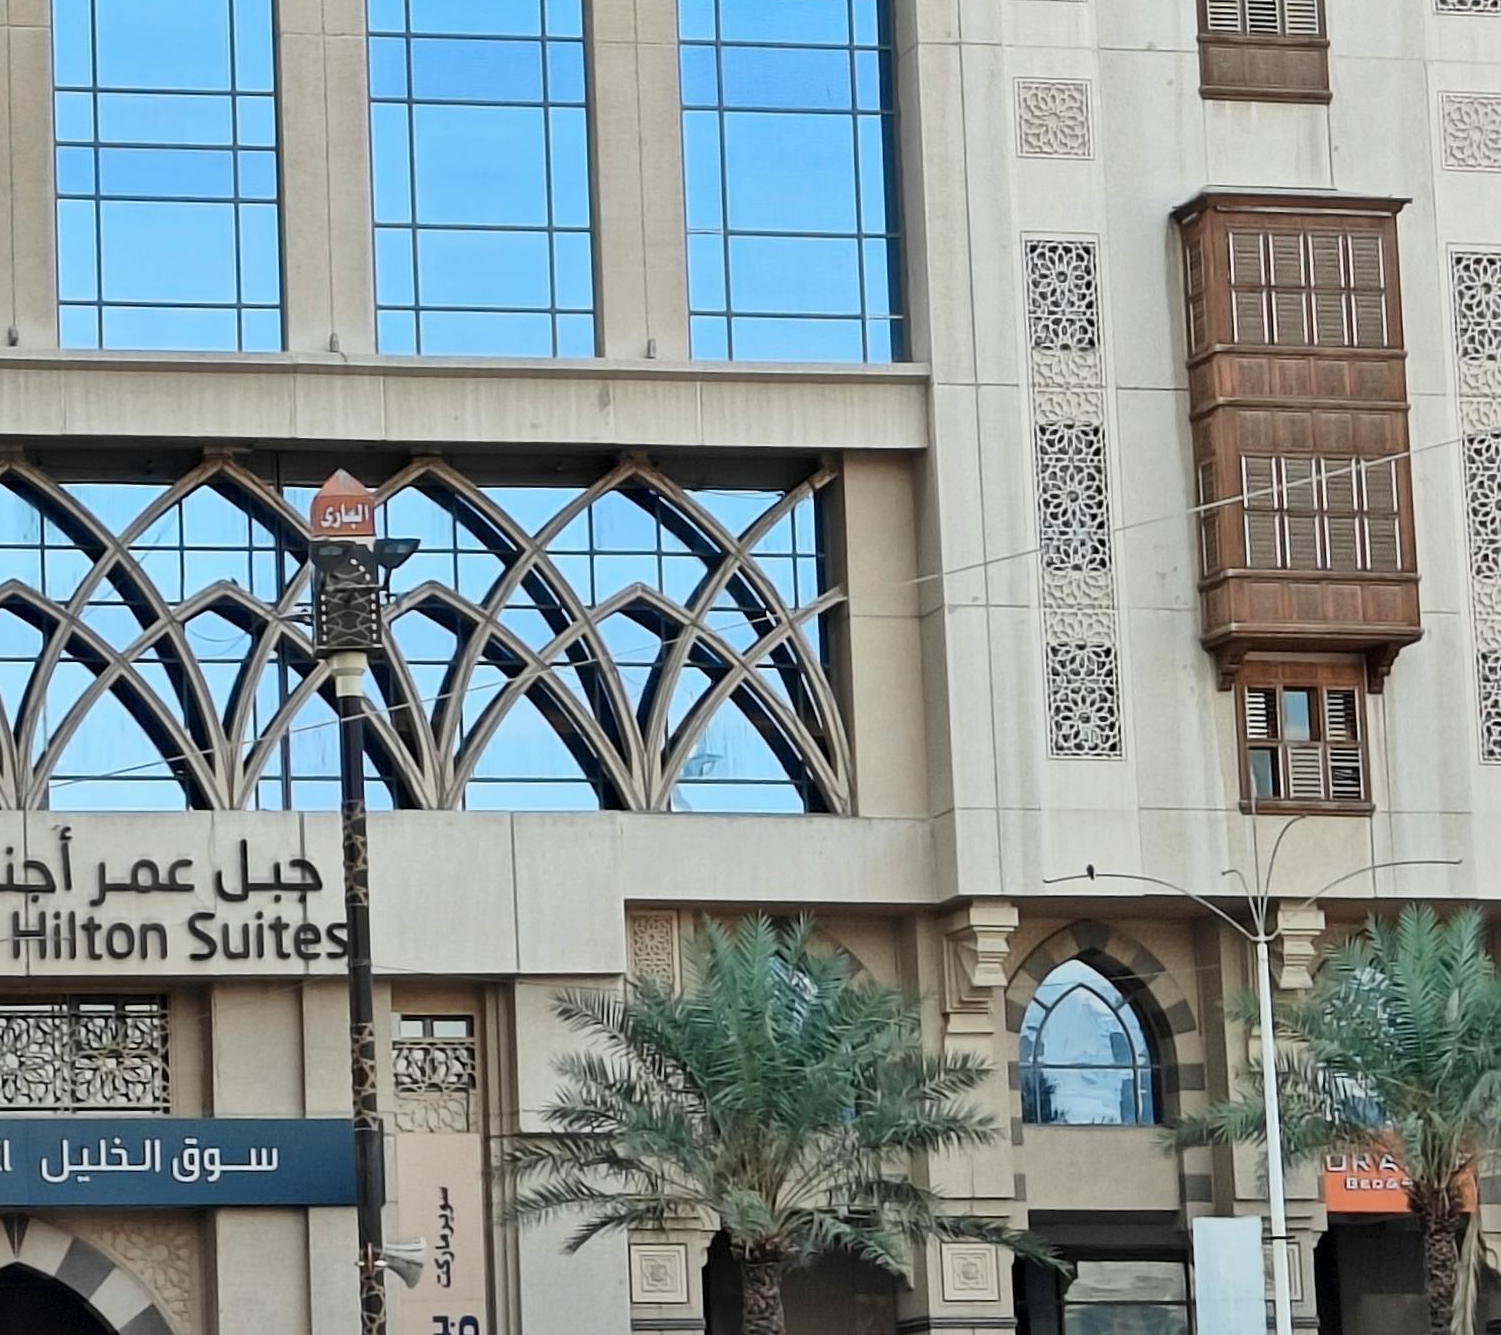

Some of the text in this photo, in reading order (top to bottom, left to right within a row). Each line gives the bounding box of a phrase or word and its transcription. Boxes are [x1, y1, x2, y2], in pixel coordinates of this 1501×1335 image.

[91, 856, 194, 906] عمر
[214, 839, 324, 904] جبل
[12, 909, 168, 960] Hilton
[189, 911, 349, 961] Suites
[41, 1137, 279, 1184] سوق الخليل
[434, 1186, 456, 1289] سوبرماركت
